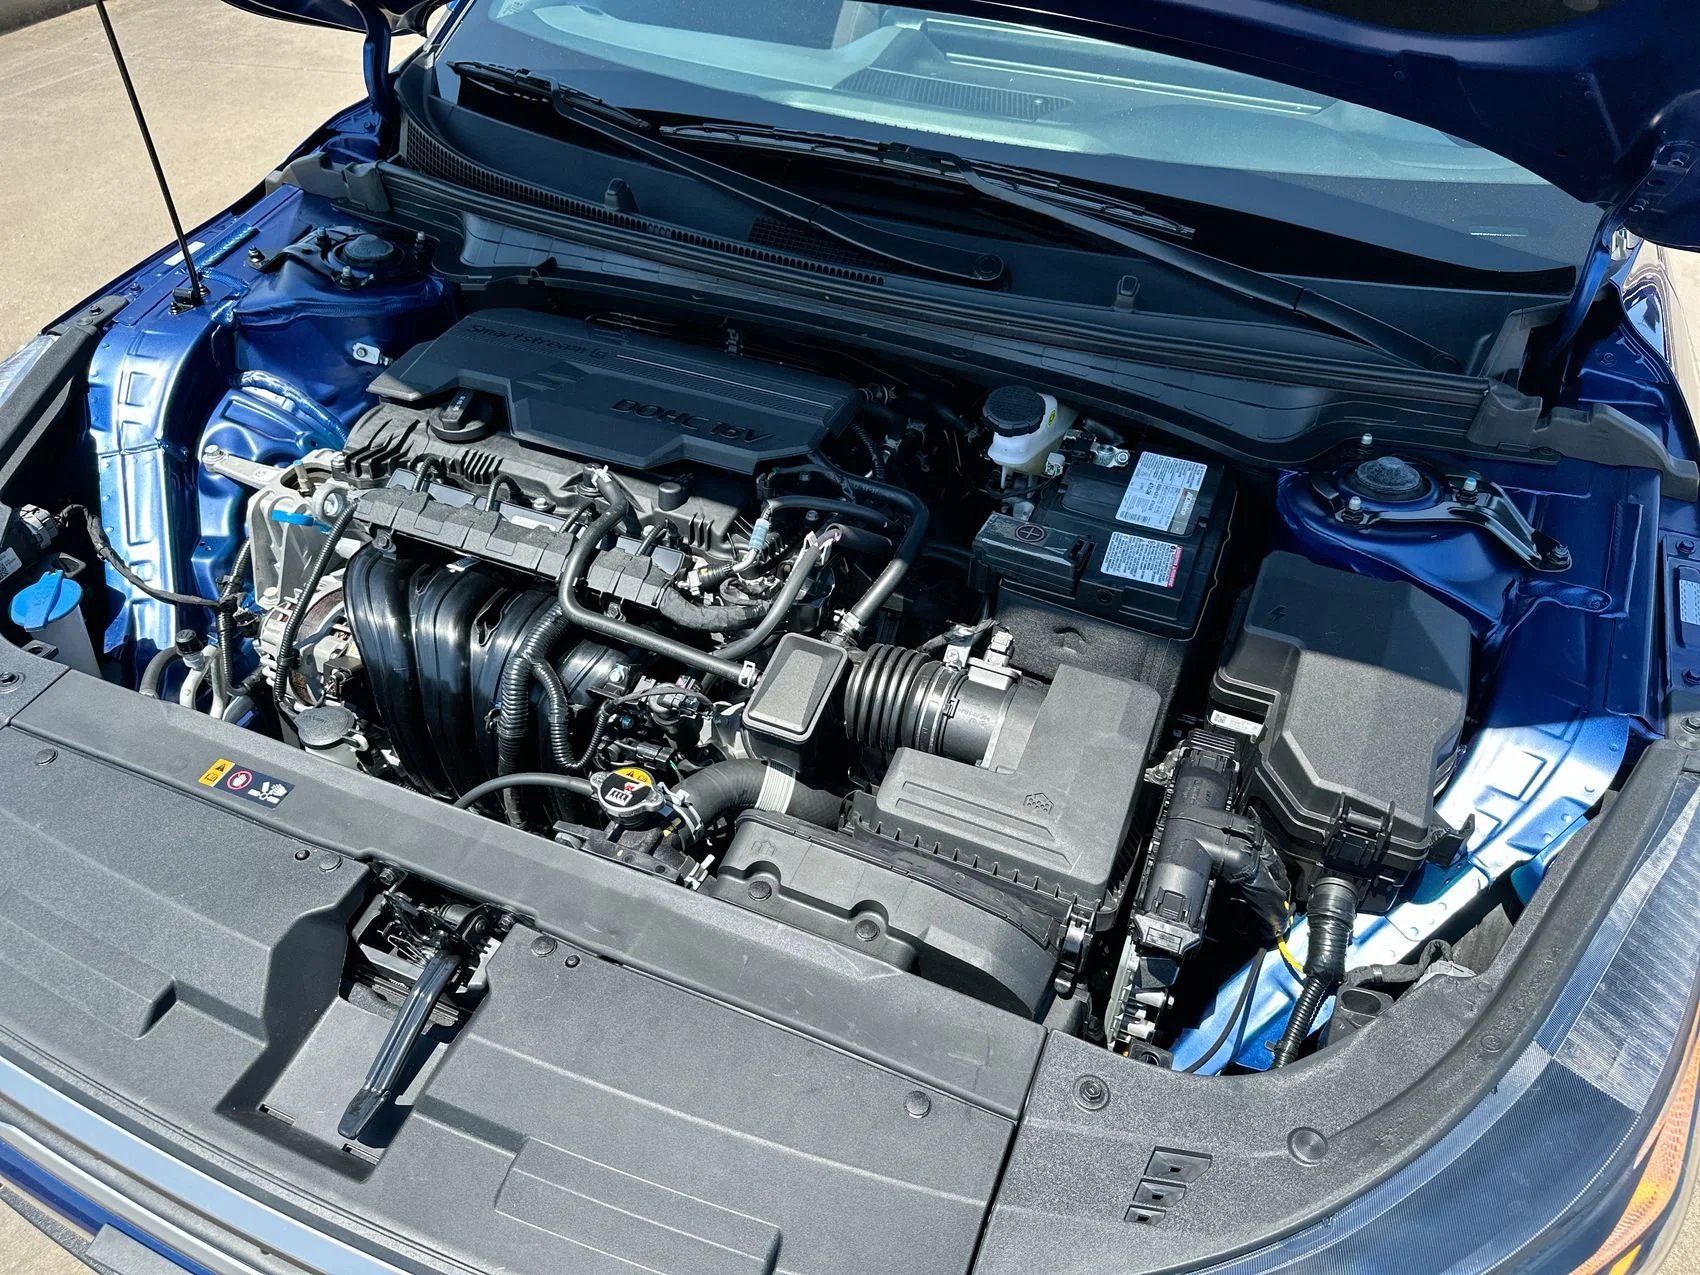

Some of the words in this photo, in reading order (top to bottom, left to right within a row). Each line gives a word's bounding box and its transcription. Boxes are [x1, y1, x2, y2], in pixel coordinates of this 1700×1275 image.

[466, 324, 587, 354] Smartstream
[610, 399, 709, 430] DOHC
[709, 421, 774, 443] 16V
